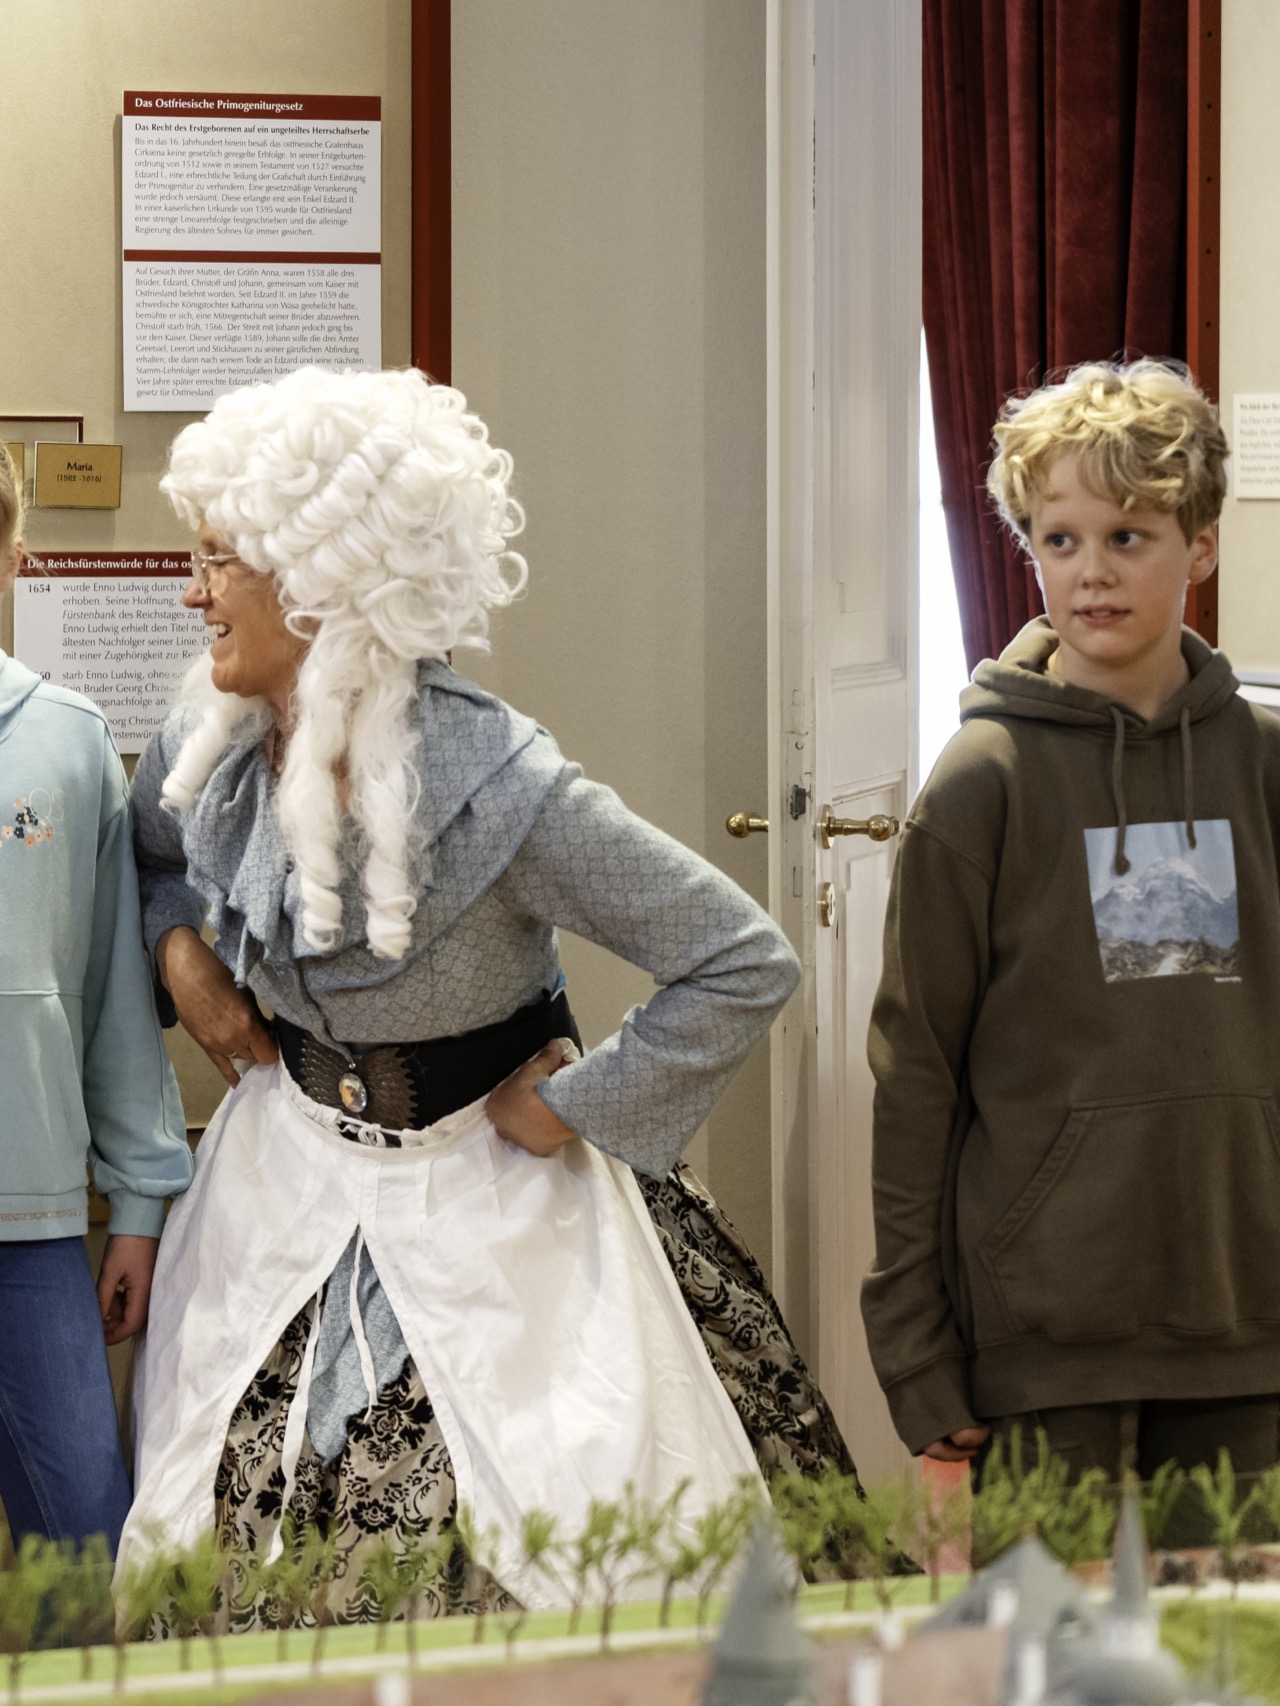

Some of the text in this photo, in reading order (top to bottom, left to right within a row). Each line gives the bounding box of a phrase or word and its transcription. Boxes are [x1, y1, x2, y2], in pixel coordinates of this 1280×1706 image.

[135, 98, 303, 113] Das Ostfriesische Primogeniturgesetz
[135, 123, 370, 136] Das Recht des Erstgeborenen auf ein ungeteiltes Herrschaftserbe
[135, 137, 145, 145] Bis
[155, 137, 168, 145] das
[182, 138, 223, 147] Jahrhundert
[224, 138, 246, 147] hinein
[248, 139, 268, 147] besaß
[270, 139, 281, 148] das
[283, 140, 324, 148] ostfriesische
[325, 140, 364, 149] Grafenhaus
[135, 267, 148, 275] Auf
[149, 267, 176, 275] Gesuch
[178, 268, 194, 276] ihrer
[196, 268, 221, 276] Mutter,
[224, 268, 235, 276] der
[237, 268, 259, 276] Gräfin
[261, 269, 281, 277] Anna,
[308, 269, 325, 277] 1558
[327, 269, 339, 277] alle
[340, 269, 355, 277] drei
[67, 462, 93, 471] Maria
[27, 558, 192, 569] Die Reichsfürstenwürde für das os
[29, 584, 51, 593] 1654
[63, 582, 176, 594] wurde Enno Ludwig durch
[63, 595, 177, 608] erhoben. Seine Hoffnung,
[63, 608, 198, 622] Fürstenbank des Reichstages zu
[63, 622, 206, 635] Enno Ludwig erhielt den Titel nur
[62, 637, 96, 647] ältesten
[99, 636, 145, 649] Nachfolger
[176, 637, 200, 646] Linie.
[63, 651, 76, 660] mit
[104, 650, 163, 662] Zugehörigkeit
[62, 670, 84, 680] starb
[86, 670, 108, 680] Enno
[111, 669, 145, 682] Ludwig,
[147, 669, 170, 679] ohne
[84, 683, 113, 693] Bruder
[116, 684, 143, 695] Georg
[145, 683, 181, 692] Christ
[93, 696, 153, 709] ngsnachfolge
[108, 719, 127, 728] eorg
